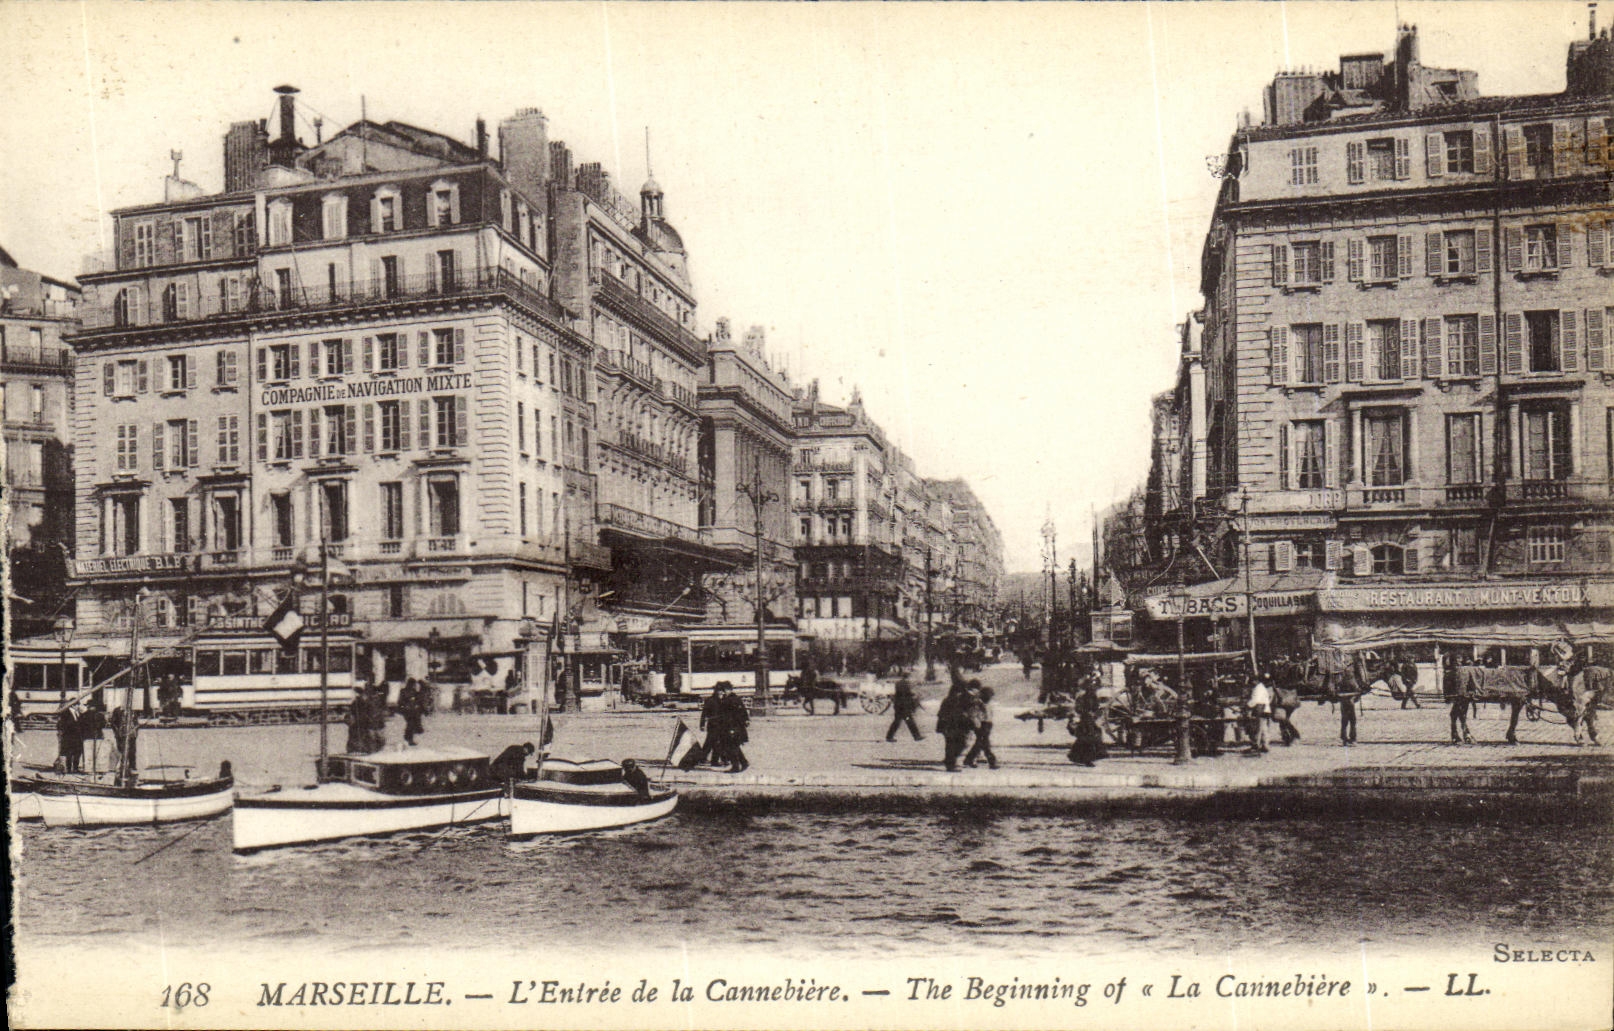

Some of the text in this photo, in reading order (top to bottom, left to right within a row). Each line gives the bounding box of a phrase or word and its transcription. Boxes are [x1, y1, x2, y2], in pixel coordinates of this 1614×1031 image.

[261, 384, 335, 406] COMPAGNIE
[347, 377, 423, 398] NAVIGATION
[426, 372, 472, 392] MIXTE
[1370, 590, 1463, 606] RESTAURANT
